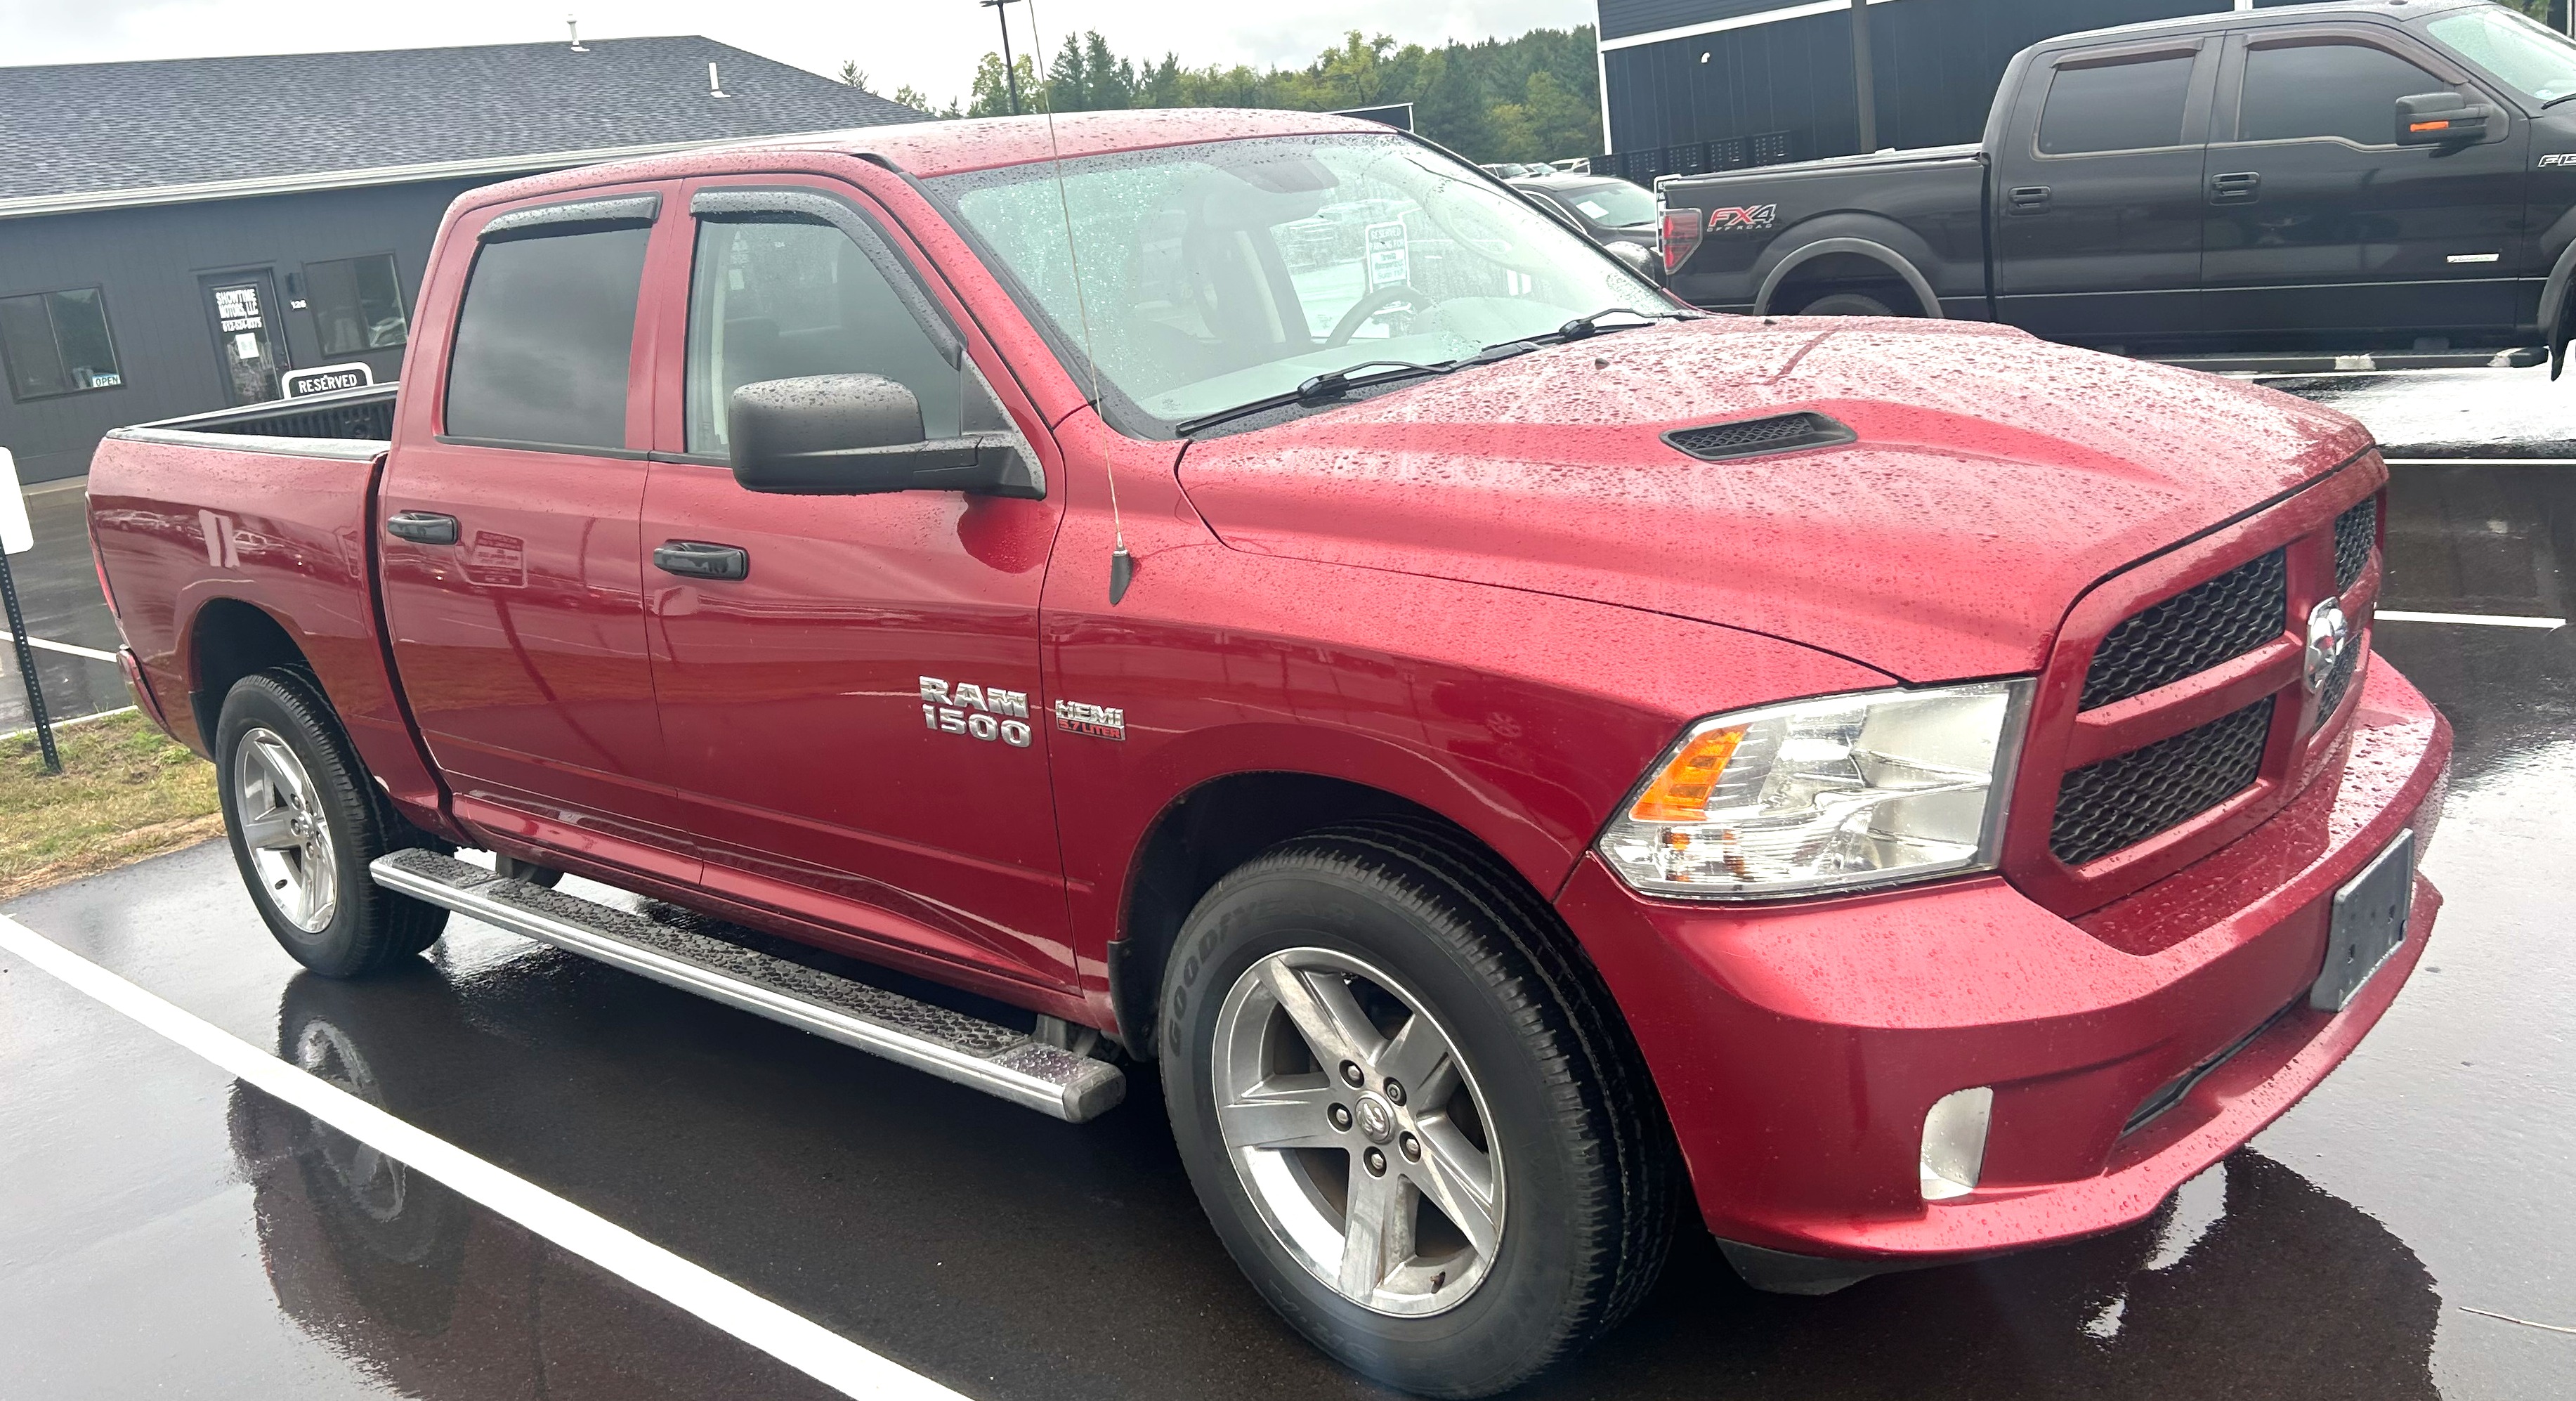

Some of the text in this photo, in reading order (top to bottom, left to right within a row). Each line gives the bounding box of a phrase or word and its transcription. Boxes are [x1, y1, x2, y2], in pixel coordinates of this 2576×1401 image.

[1708, 203, 1777, 228] FX4
[216, 289, 256, 305] SHOWTIME
[245, 301, 259, 316] LLC
[96, 376, 119, 386] OPEN
[299, 374, 358, 393] RESERVED
[919, 675, 1030, 719] RAM
[1055, 699, 1124, 726] HEMI
[922, 703, 1032, 748] 1500
[1059, 718, 1121, 739] 5.7 LITER
